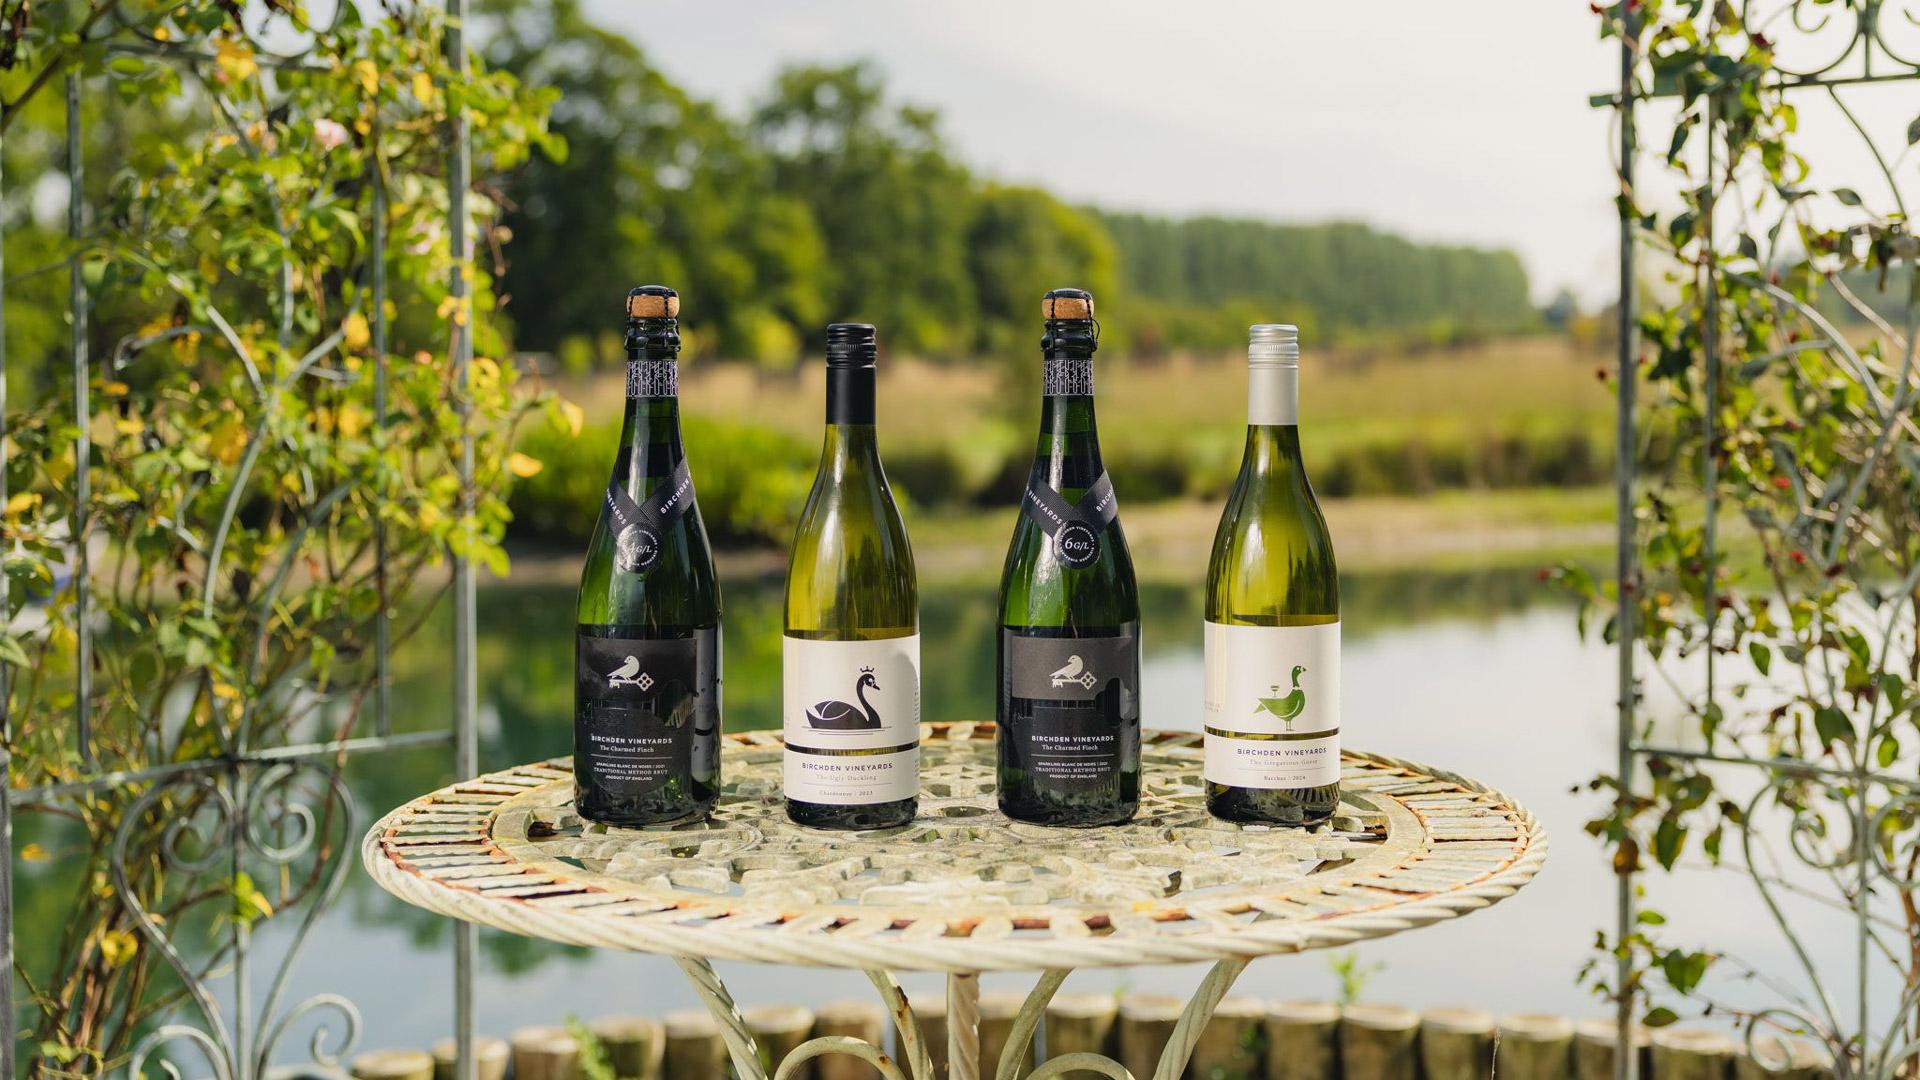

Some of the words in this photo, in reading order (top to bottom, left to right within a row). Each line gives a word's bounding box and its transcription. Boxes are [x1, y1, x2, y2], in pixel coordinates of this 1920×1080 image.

[660, 478, 689, 514] BIRCHDEN
[1028, 490, 1063, 525] VINEYARDS
[591, 735, 625, 744] BIRCHDEN
[1031, 735, 1070, 743] BIRCHDEN
[1072, 735, 1114, 743] VINEYARDS
[600, 744, 611, 752] The
[611, 745, 635, 753] Charmed
[1054, 744, 1081, 752] Charmed
[1237, 748, 1281, 757] BIRCHDEN
[1284, 747, 1327, 756] VINEYARDS
[593, 767, 627, 775] TRADITIONAL
[802, 762, 841, 772] BIRCHDEN
[845, 762, 893, 772] VINEYARDS
